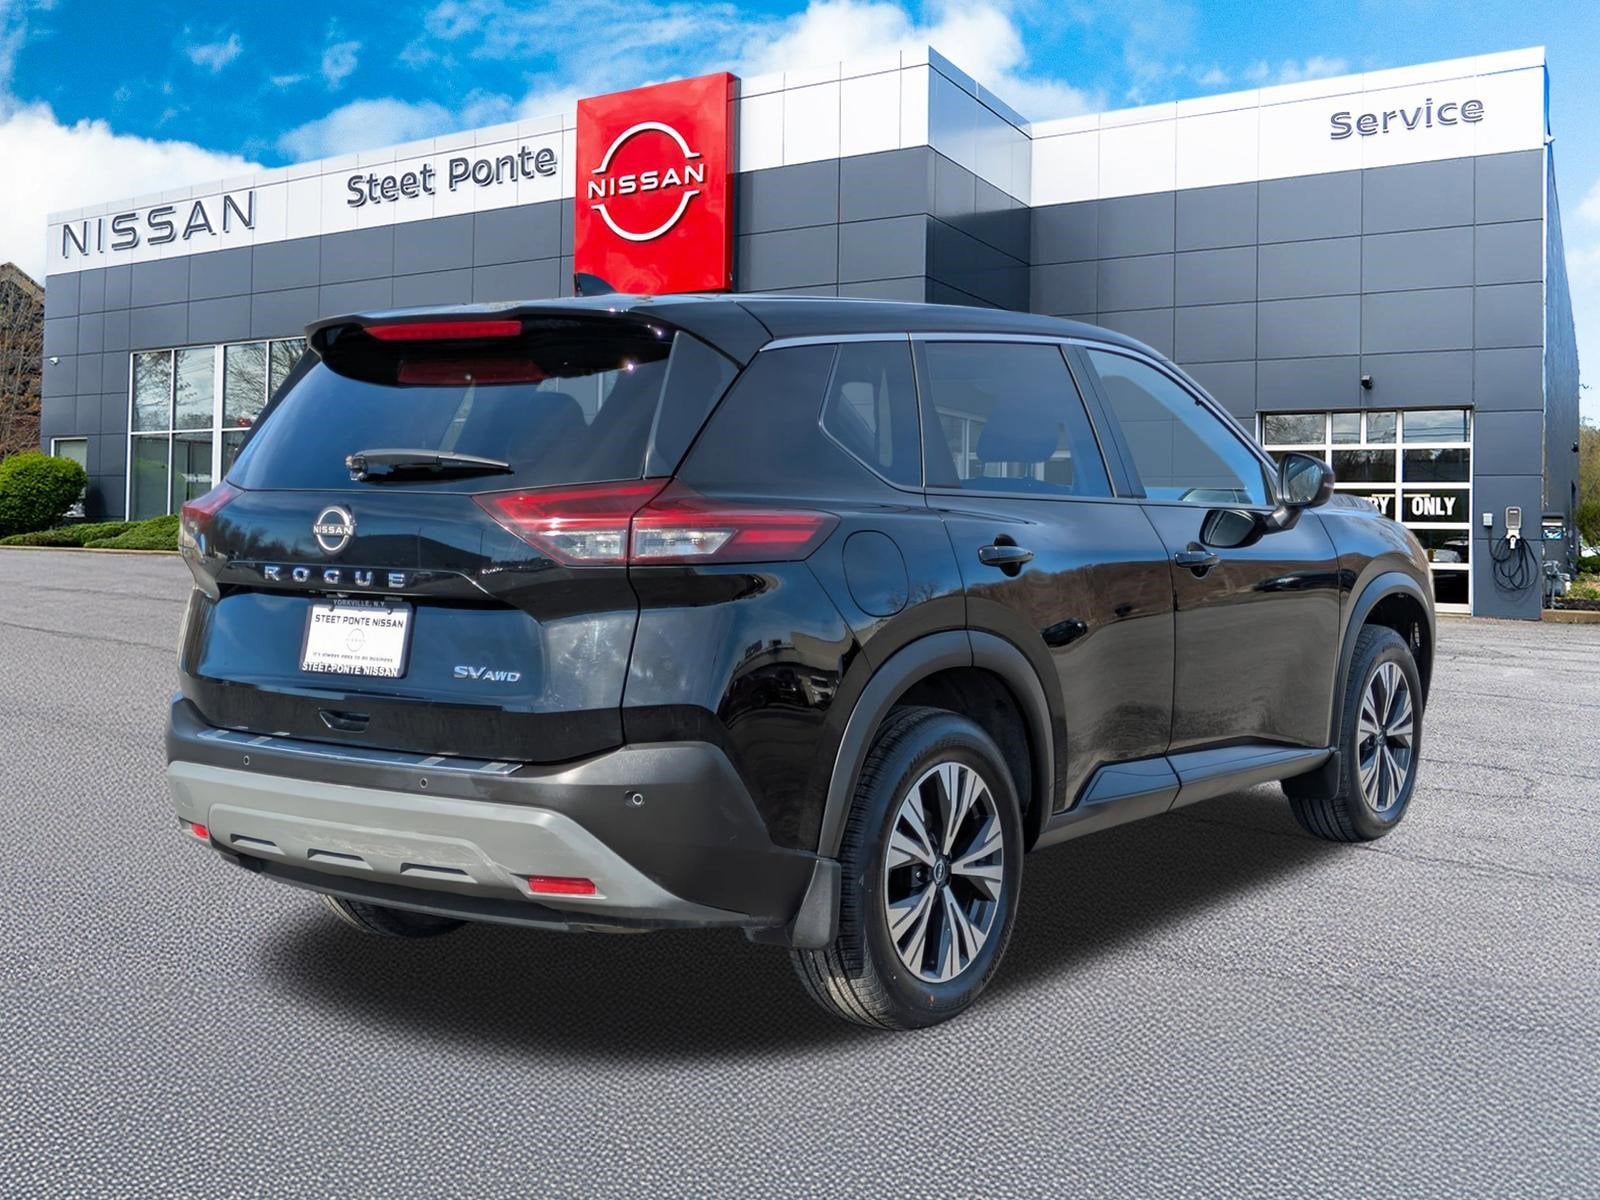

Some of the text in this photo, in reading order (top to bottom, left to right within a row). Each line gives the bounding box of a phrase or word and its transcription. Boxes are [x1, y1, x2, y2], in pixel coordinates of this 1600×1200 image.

[1329, 98, 1485, 140] Service
[346, 145, 558, 207] Steet Ponte
[587, 163, 706, 200] NISSAN
[61, 190, 256, 259] NISSAN
[1411, 496, 1457, 516] ONLY
[313, 525, 354, 536] NISSAN
[263, 565, 406, 589] ROGUE
[314, 614, 404, 629] STEET PONTE NISSAN
[362, 666, 399, 678] NISSAN
